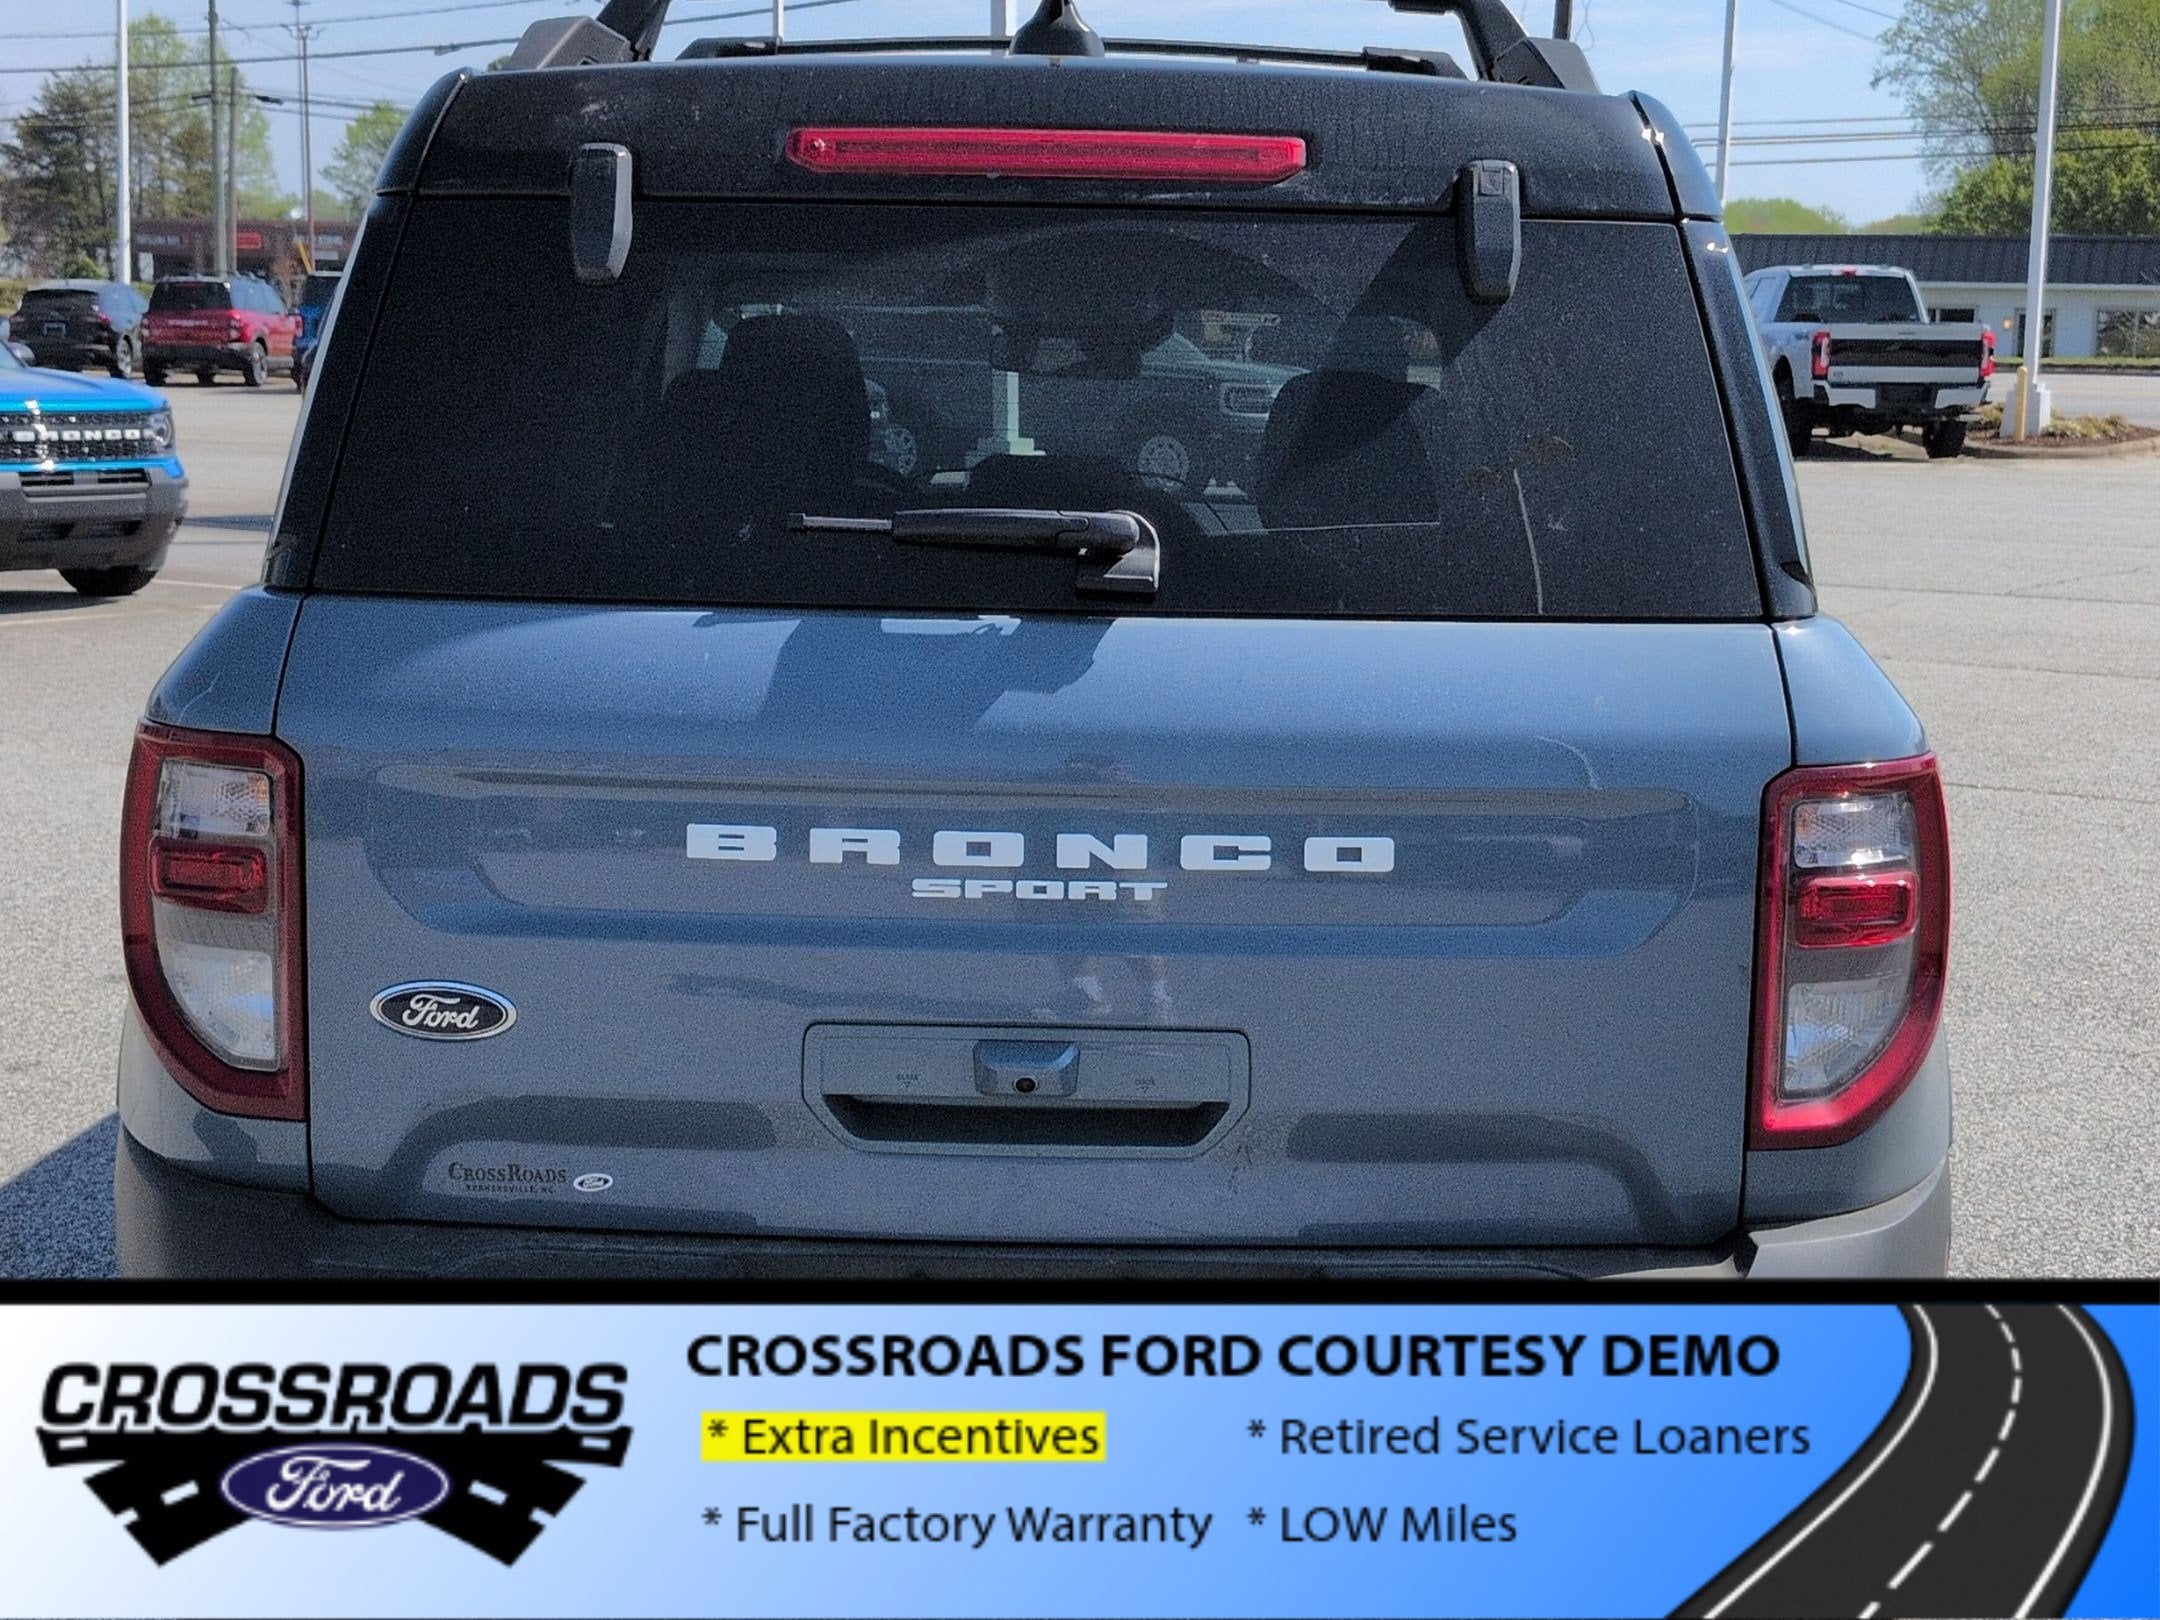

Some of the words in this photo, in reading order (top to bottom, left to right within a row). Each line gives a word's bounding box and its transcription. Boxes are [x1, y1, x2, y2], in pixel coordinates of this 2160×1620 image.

[685, 822, 1396, 873] BRONCO
[911, 878, 1169, 901] SPORT
[402, 994, 481, 1029] Ford
